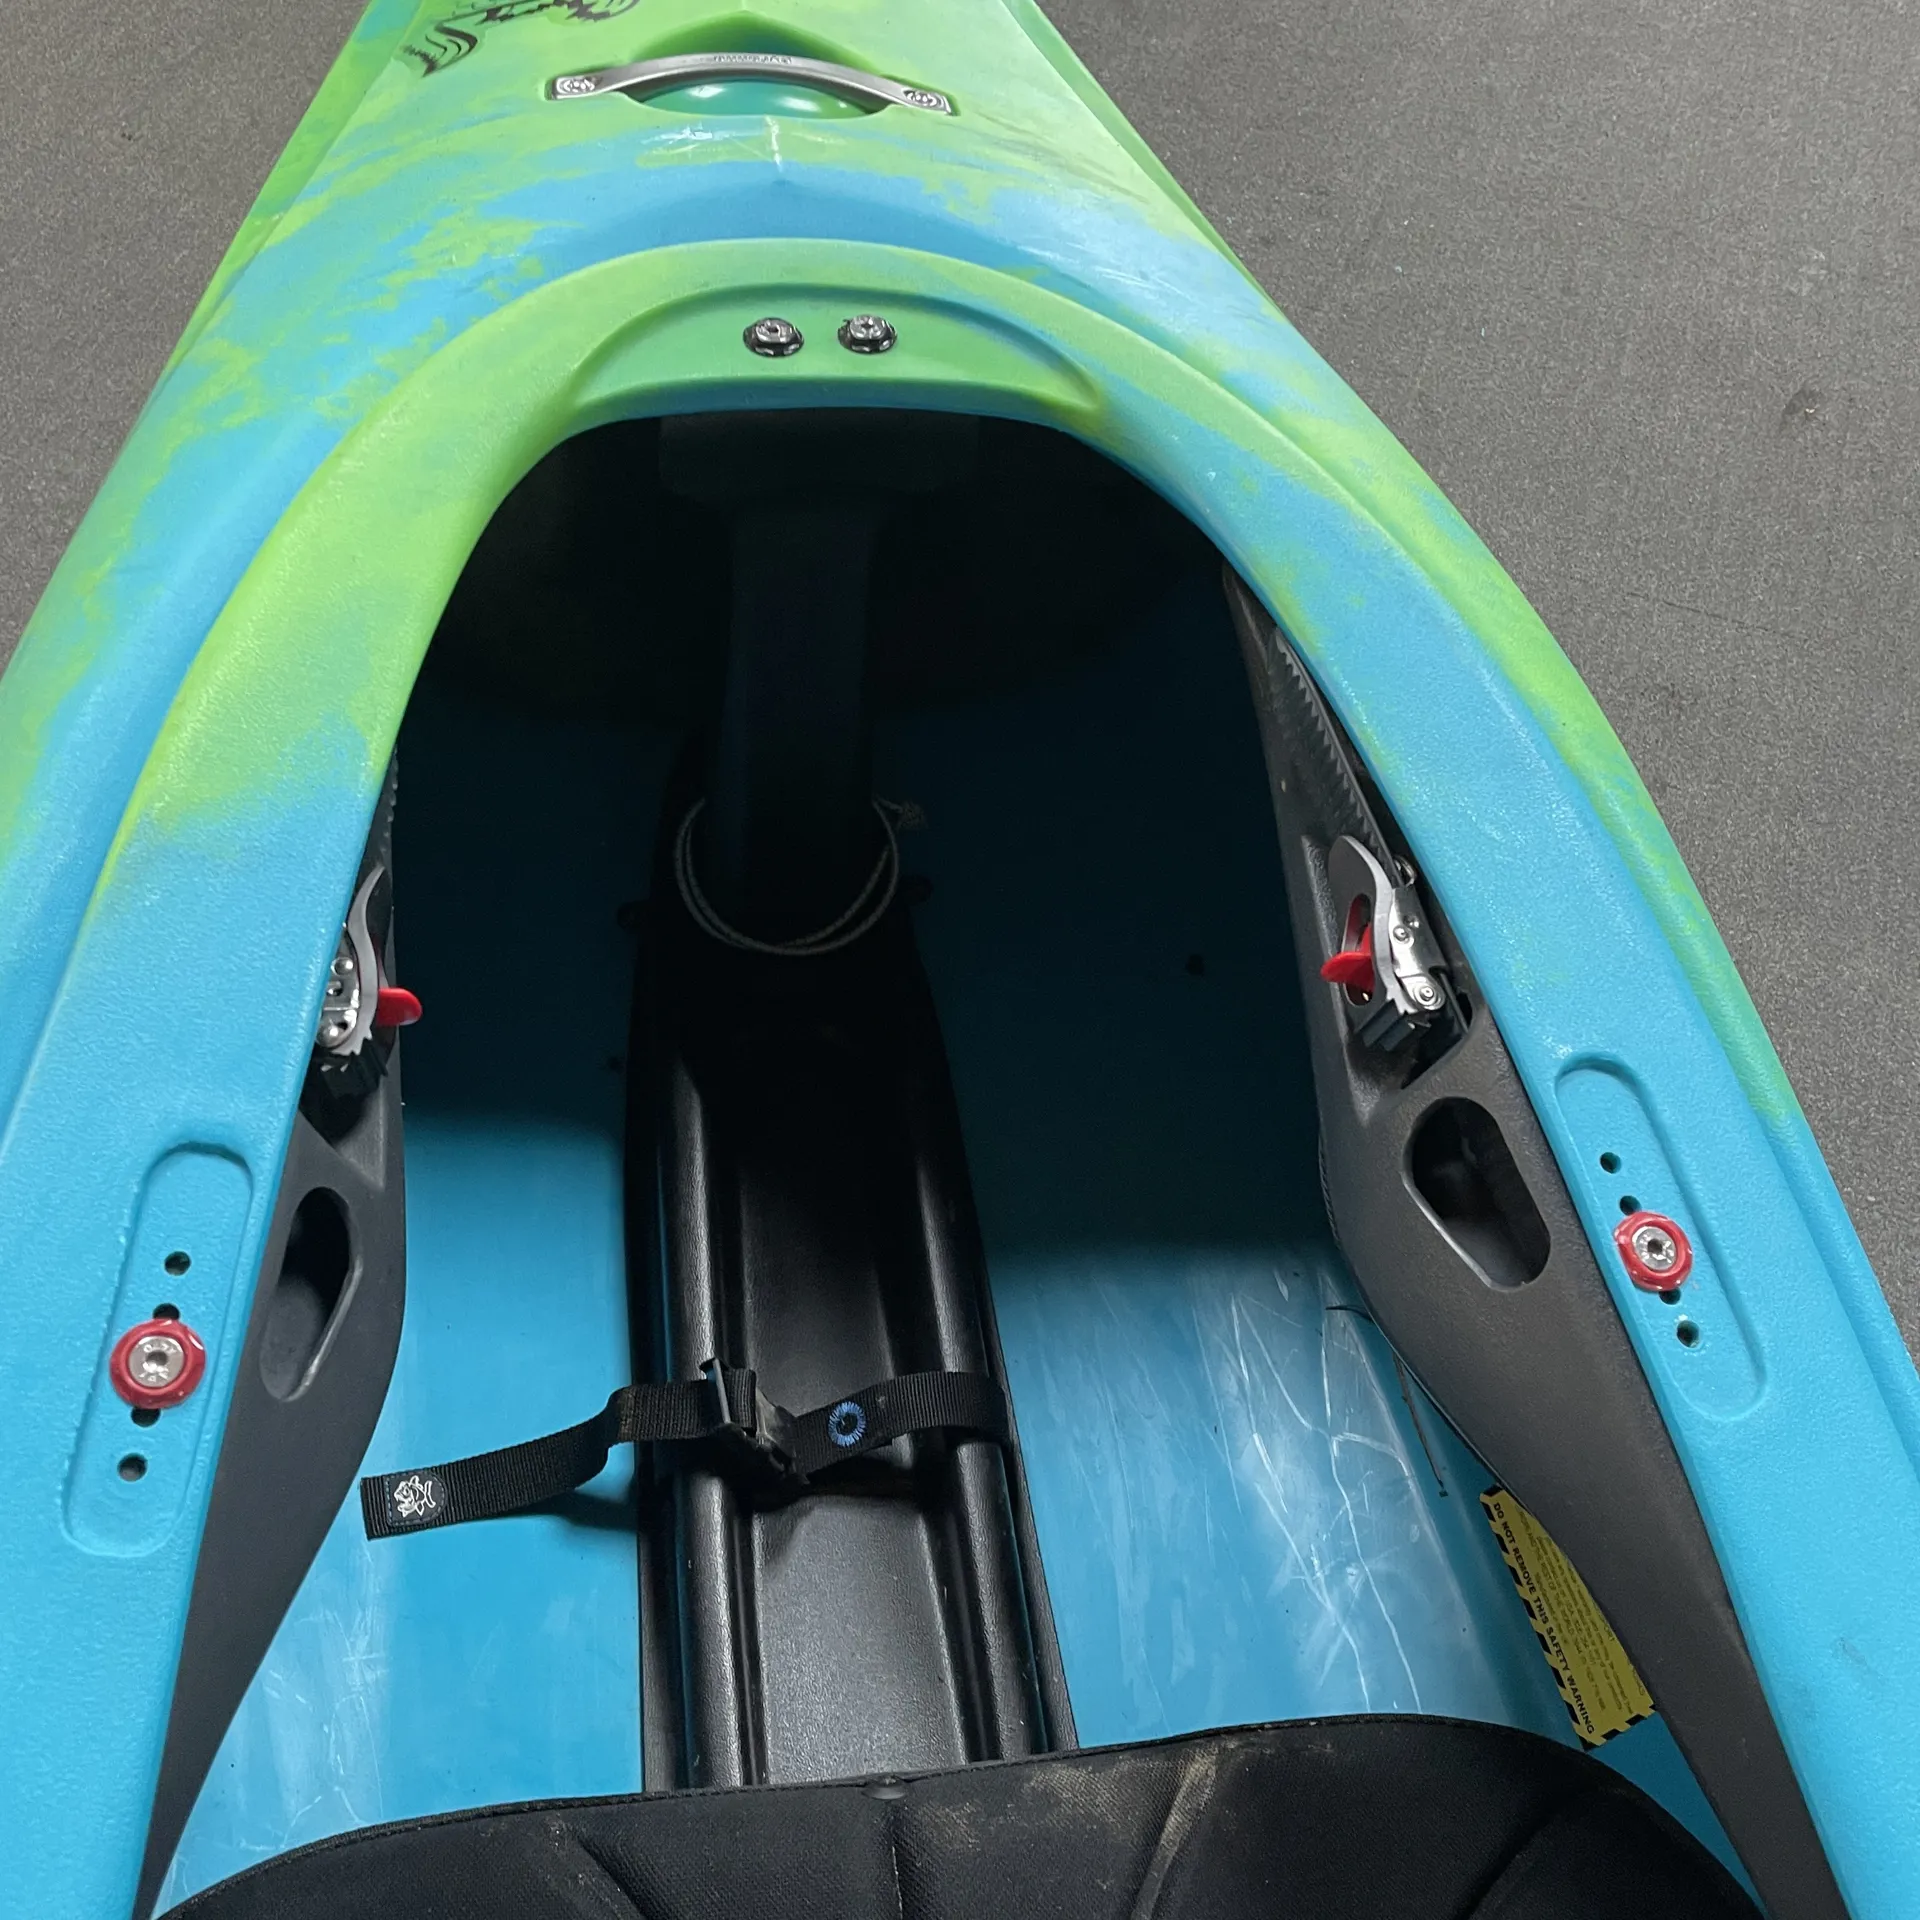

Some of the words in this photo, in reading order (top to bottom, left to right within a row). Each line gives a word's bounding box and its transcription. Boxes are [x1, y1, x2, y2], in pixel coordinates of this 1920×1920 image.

[1492, 1502, 1505, 1519] DO
[1500, 1521, 1515, 1545] NOT
[1511, 1547, 1536, 1594] REMOVE
[1532, 1596, 1549, 1624] THIS
[1545, 1626, 1570, 1673] SAFETY
[1565, 1674, 1596, 1734] WARNING
